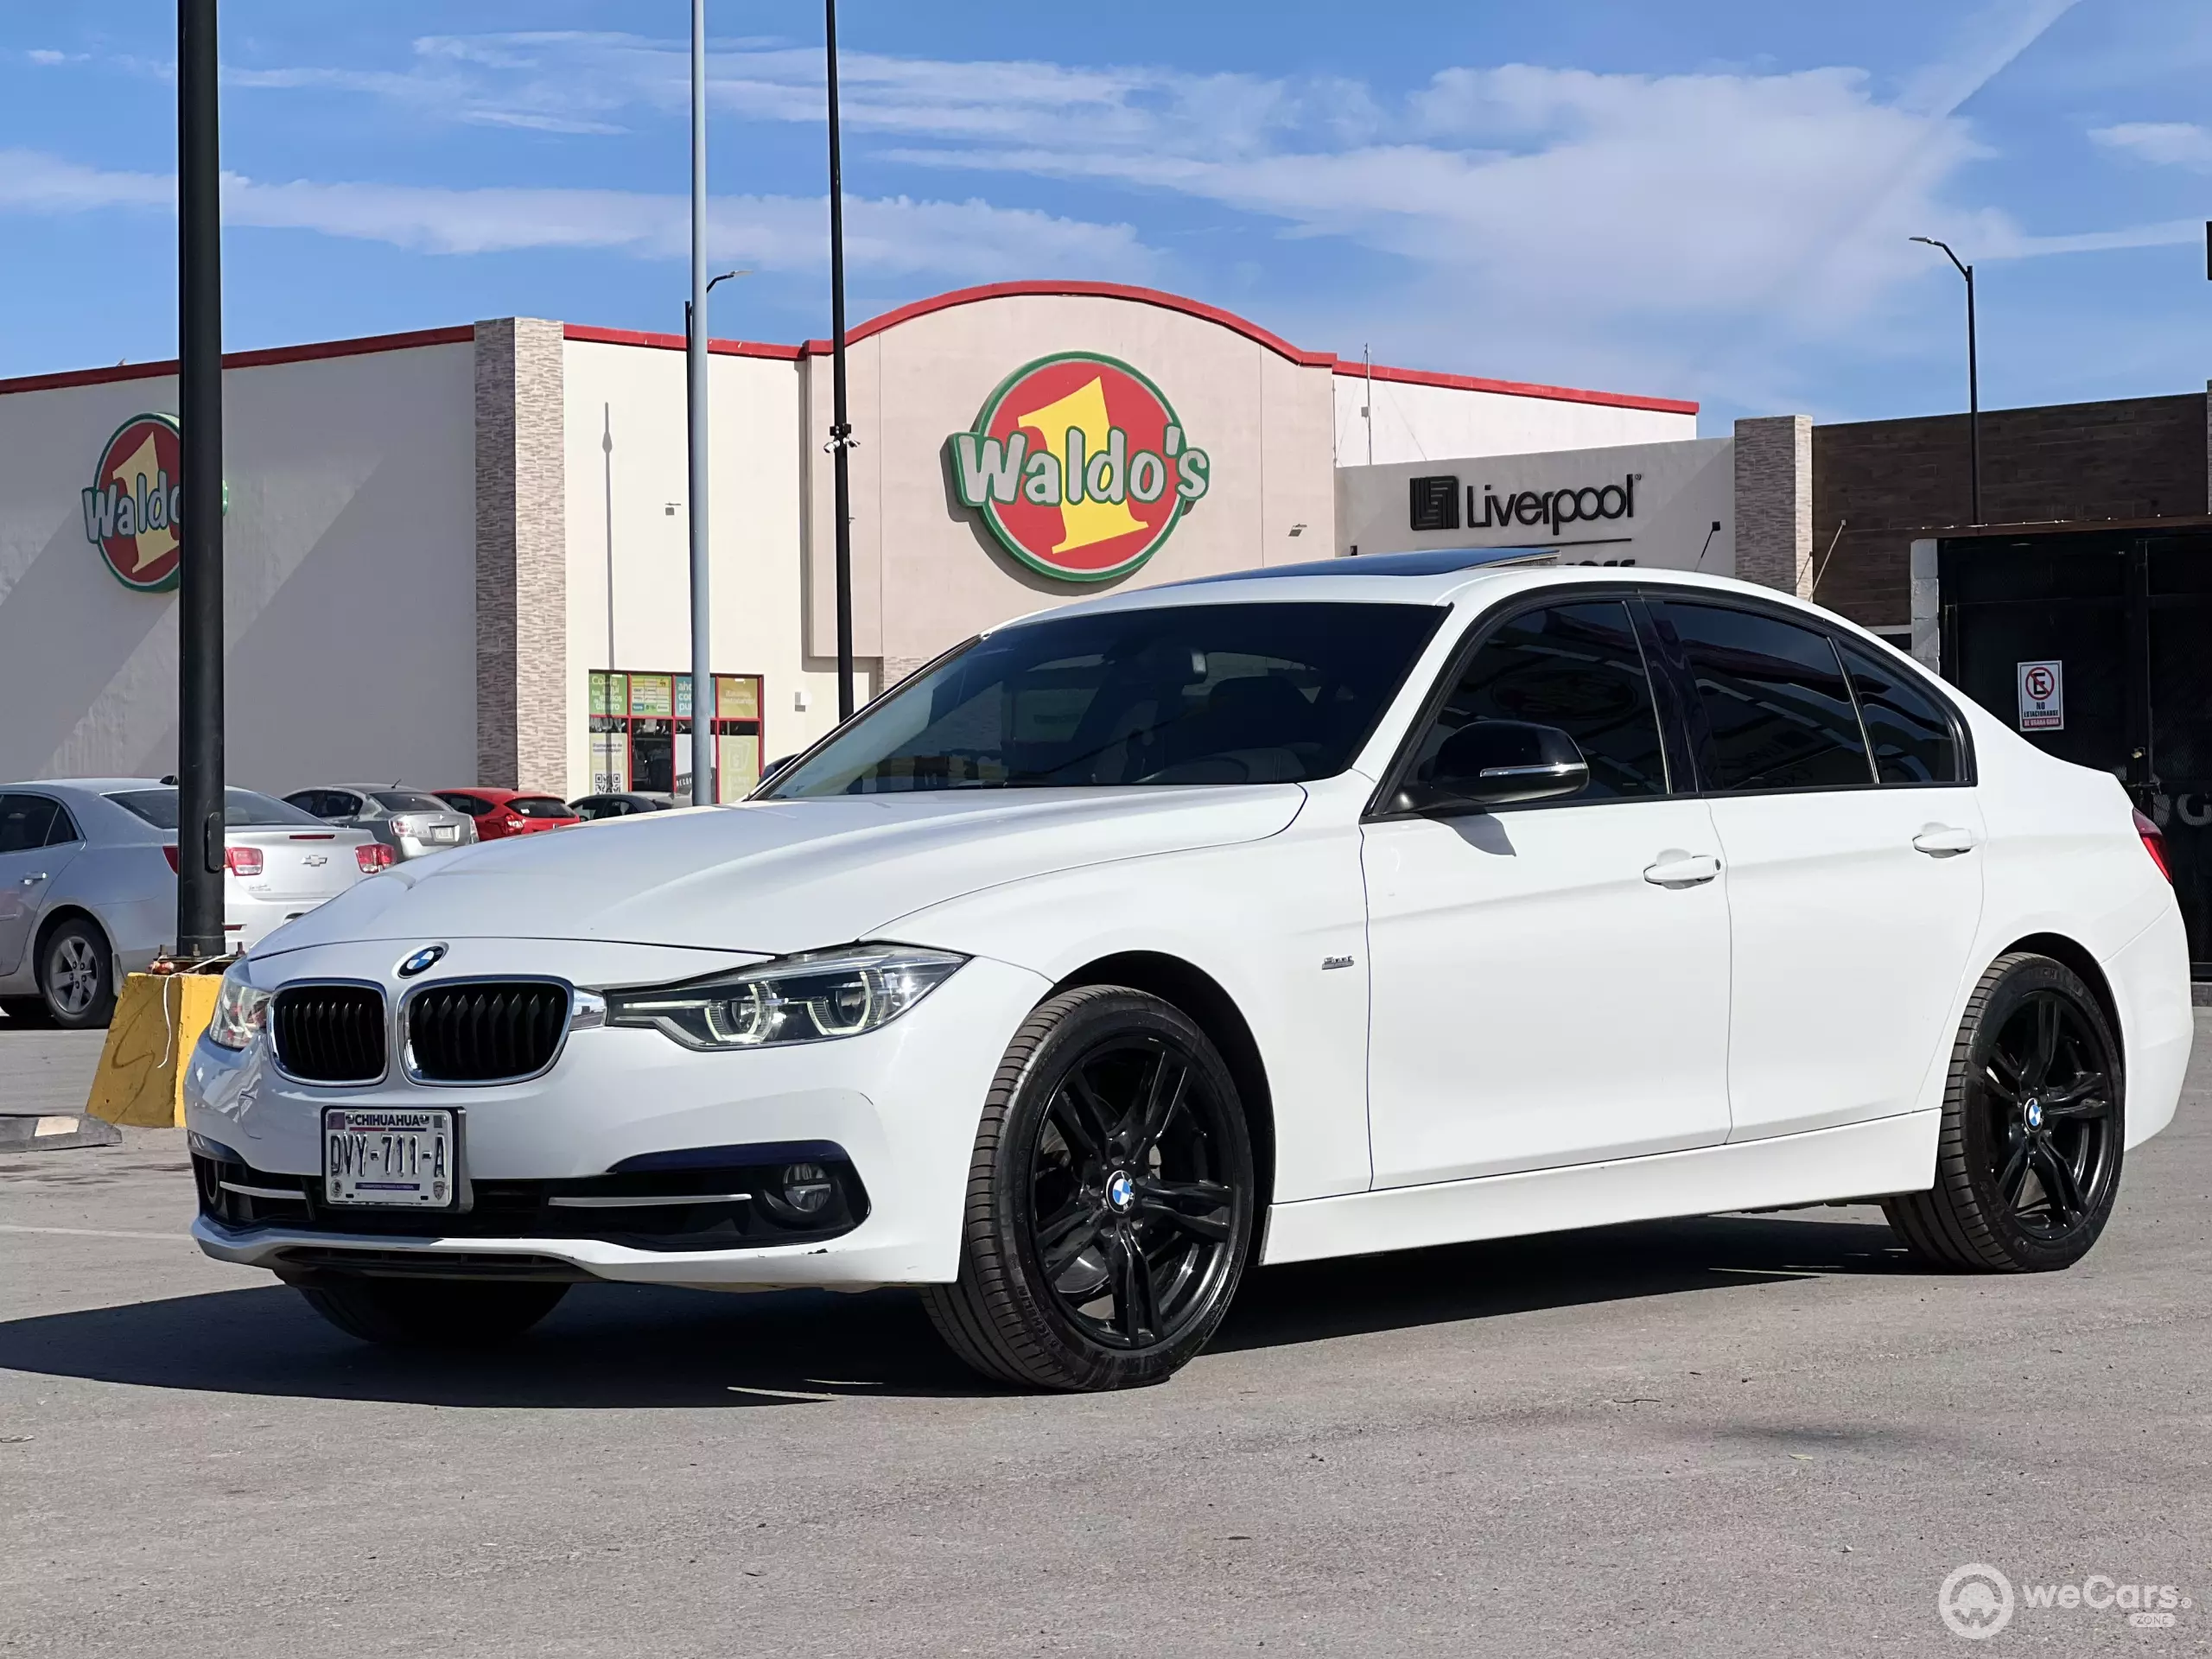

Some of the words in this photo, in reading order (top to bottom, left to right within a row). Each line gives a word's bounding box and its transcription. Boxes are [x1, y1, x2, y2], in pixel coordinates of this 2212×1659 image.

[953, 424, 1210, 507] Waldo's
[1467, 473, 1635, 536] Liverpool
[2036, 702, 2045, 710] NO
[354, 1114, 421, 1126] CHIHUAHUA
[330, 1131, 448, 1178] DVY-711-A
